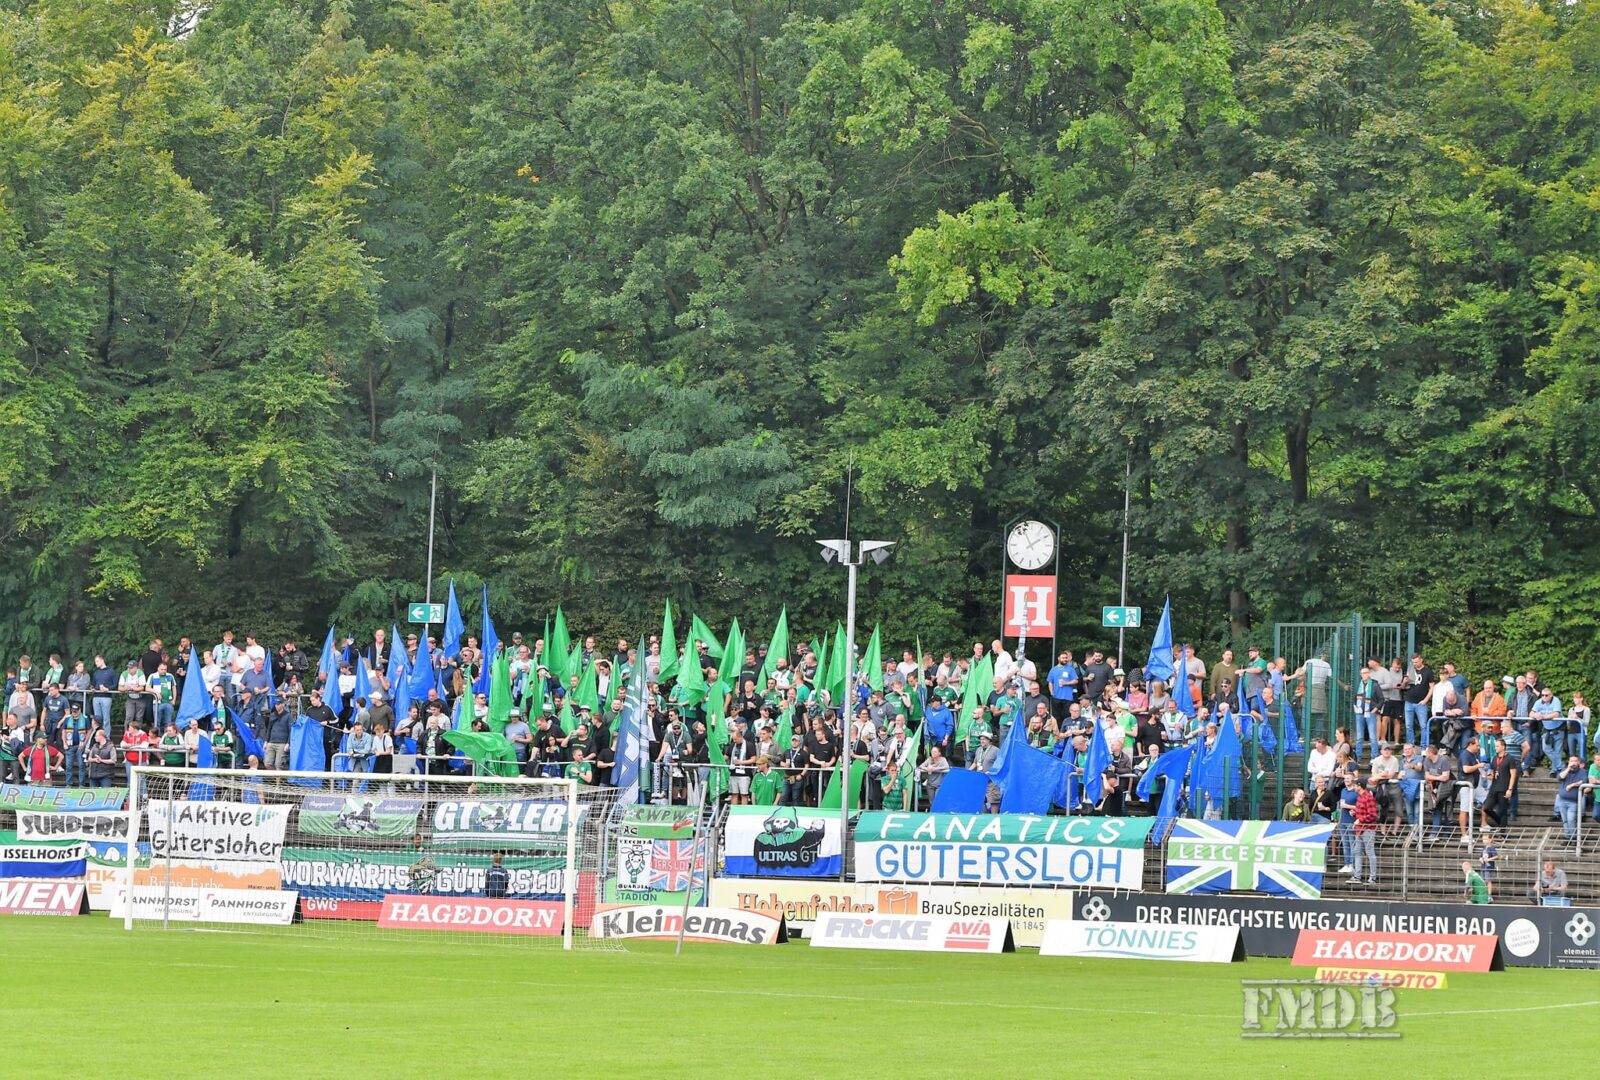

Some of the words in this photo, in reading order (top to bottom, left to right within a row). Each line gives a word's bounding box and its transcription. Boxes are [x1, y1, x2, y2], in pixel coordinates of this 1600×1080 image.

[4, 788, 121, 806] RHEDA
[22, 815, 130, 838] SUNDERN
[178, 805, 252, 826] Aktive
[880, 813, 1126, 844] FANATICS
[4, 847, 82, 860] ISSELHORST
[152, 830, 282, 856] Gütersloher
[1179, 844, 1313, 864] LEICESTER
[759, 851, 797, 862] ULTRAS
[875, 843, 1122, 883] GÜTERSLOH
[281, 858, 408, 890] VORWÄRTS
[434, 863, 579, 893] GÜTRSLOH
[210, 899, 287, 910] PANNHORST
[307, 899, 338, 912] GWG
[389, 902, 558, 928] HAGEDORN
[922, 900, 1045, 918] BrauSpezialitäten
[602, 908, 767, 944] Kleinemas
[1024, 921, 1045, 931] 1845
[1137, 906, 1172, 924] DER
[1181, 908, 1284, 929] EINFACHSTE
[1288, 911, 1330, 930] WEG
[1335, 914, 1376, 932] ZUM
[1383, 915, 1449, 935] NEUEN
[1456, 918, 1496, 936] BAD
[1085, 923, 1198, 950] TÖNNIES
[1312, 939, 1476, 963] HAGEDORN
[1564, 948, 1596, 956] elements
